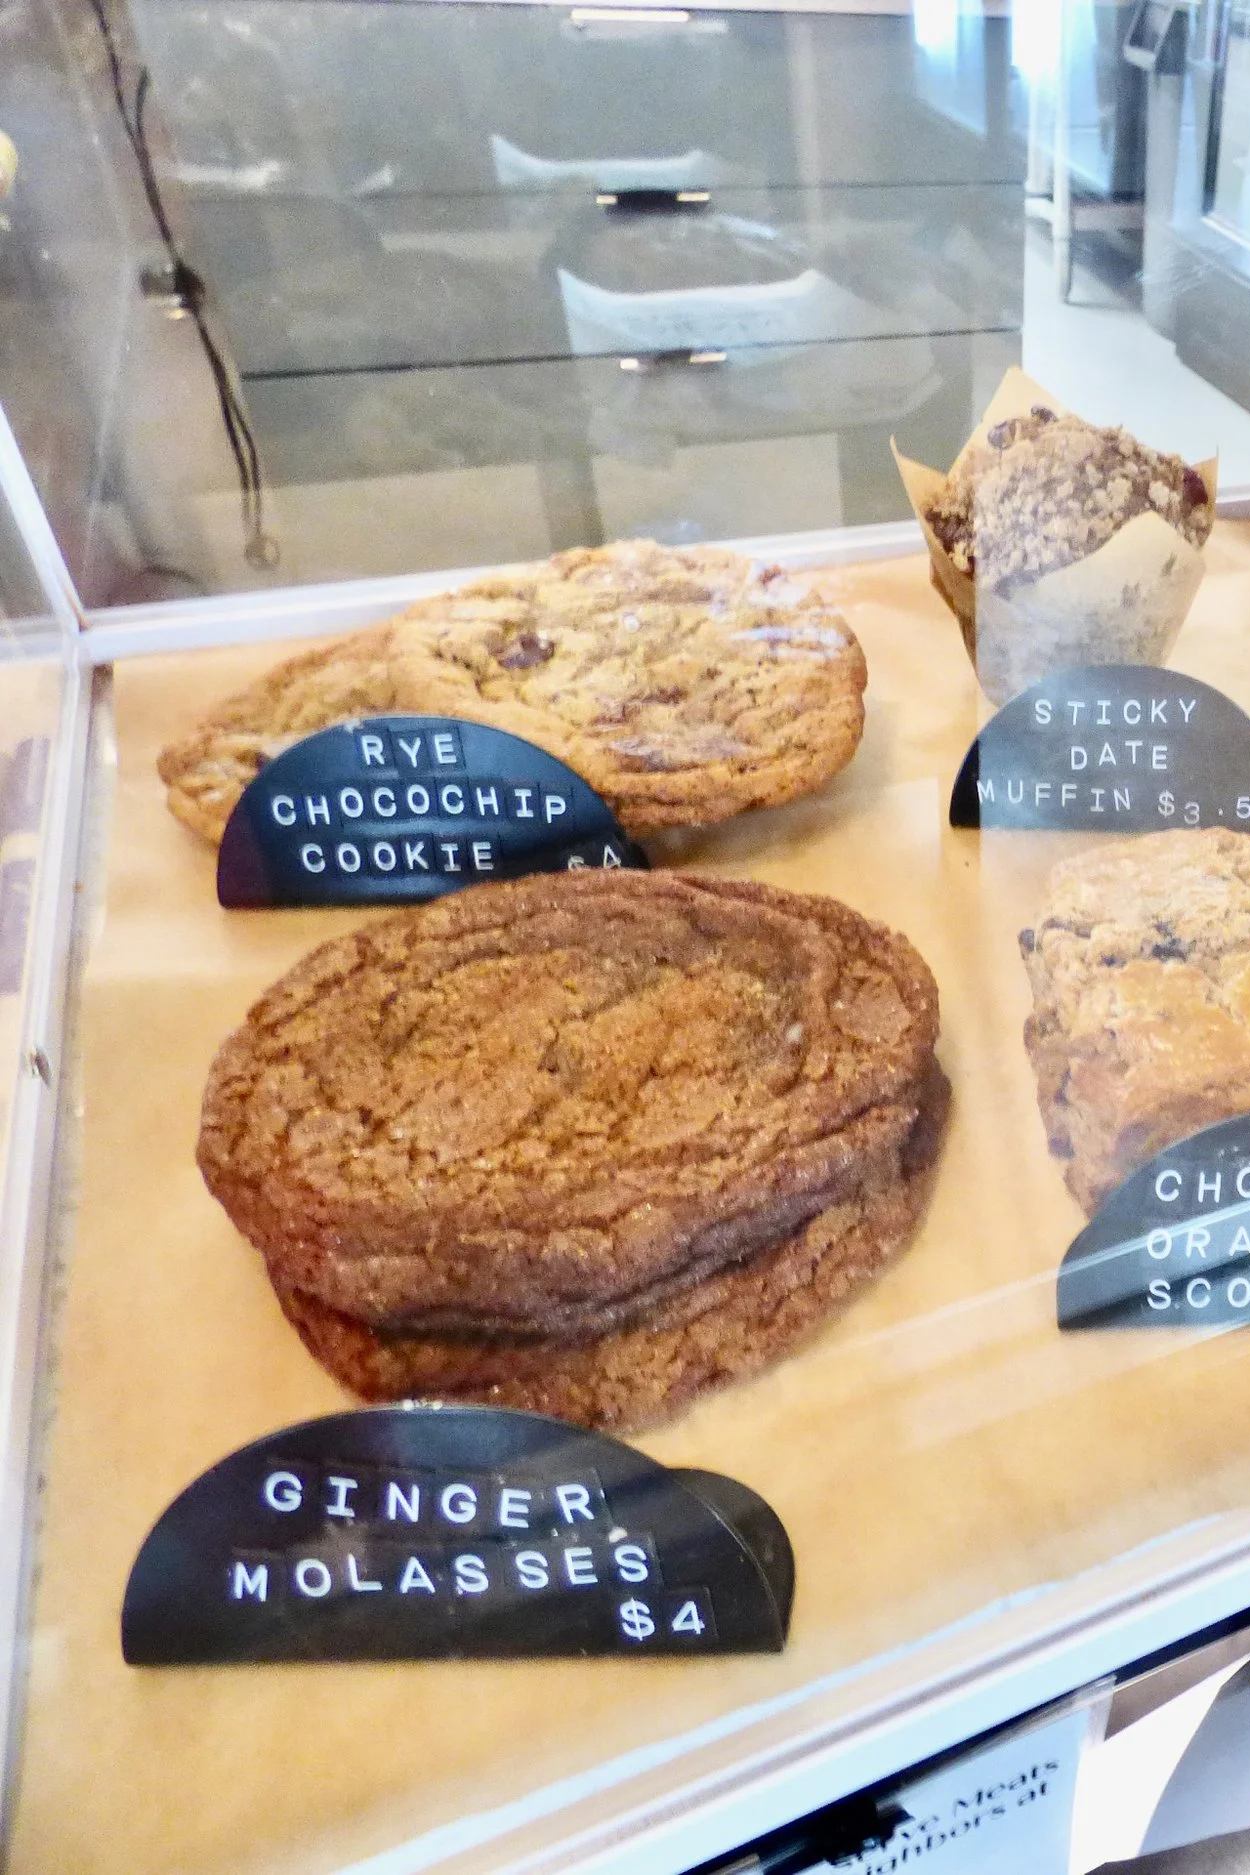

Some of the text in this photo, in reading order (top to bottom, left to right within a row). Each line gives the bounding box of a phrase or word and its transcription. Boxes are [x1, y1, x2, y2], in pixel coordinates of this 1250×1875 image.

[1035, 699, 1197, 726] STICKY
[363, 731, 458, 767] RYE
[1071, 740, 1168, 770] DATE
[272, 784, 567, 827] CHOCOCHIP
[977, 779, 1131, 812] MUFFIN
[301, 841, 494, 874] COOKIE
[264, 1471, 595, 1529] GINGER
[233, 1545, 649, 1603] MOLASSES
[620, 1597, 703, 1641] $4
